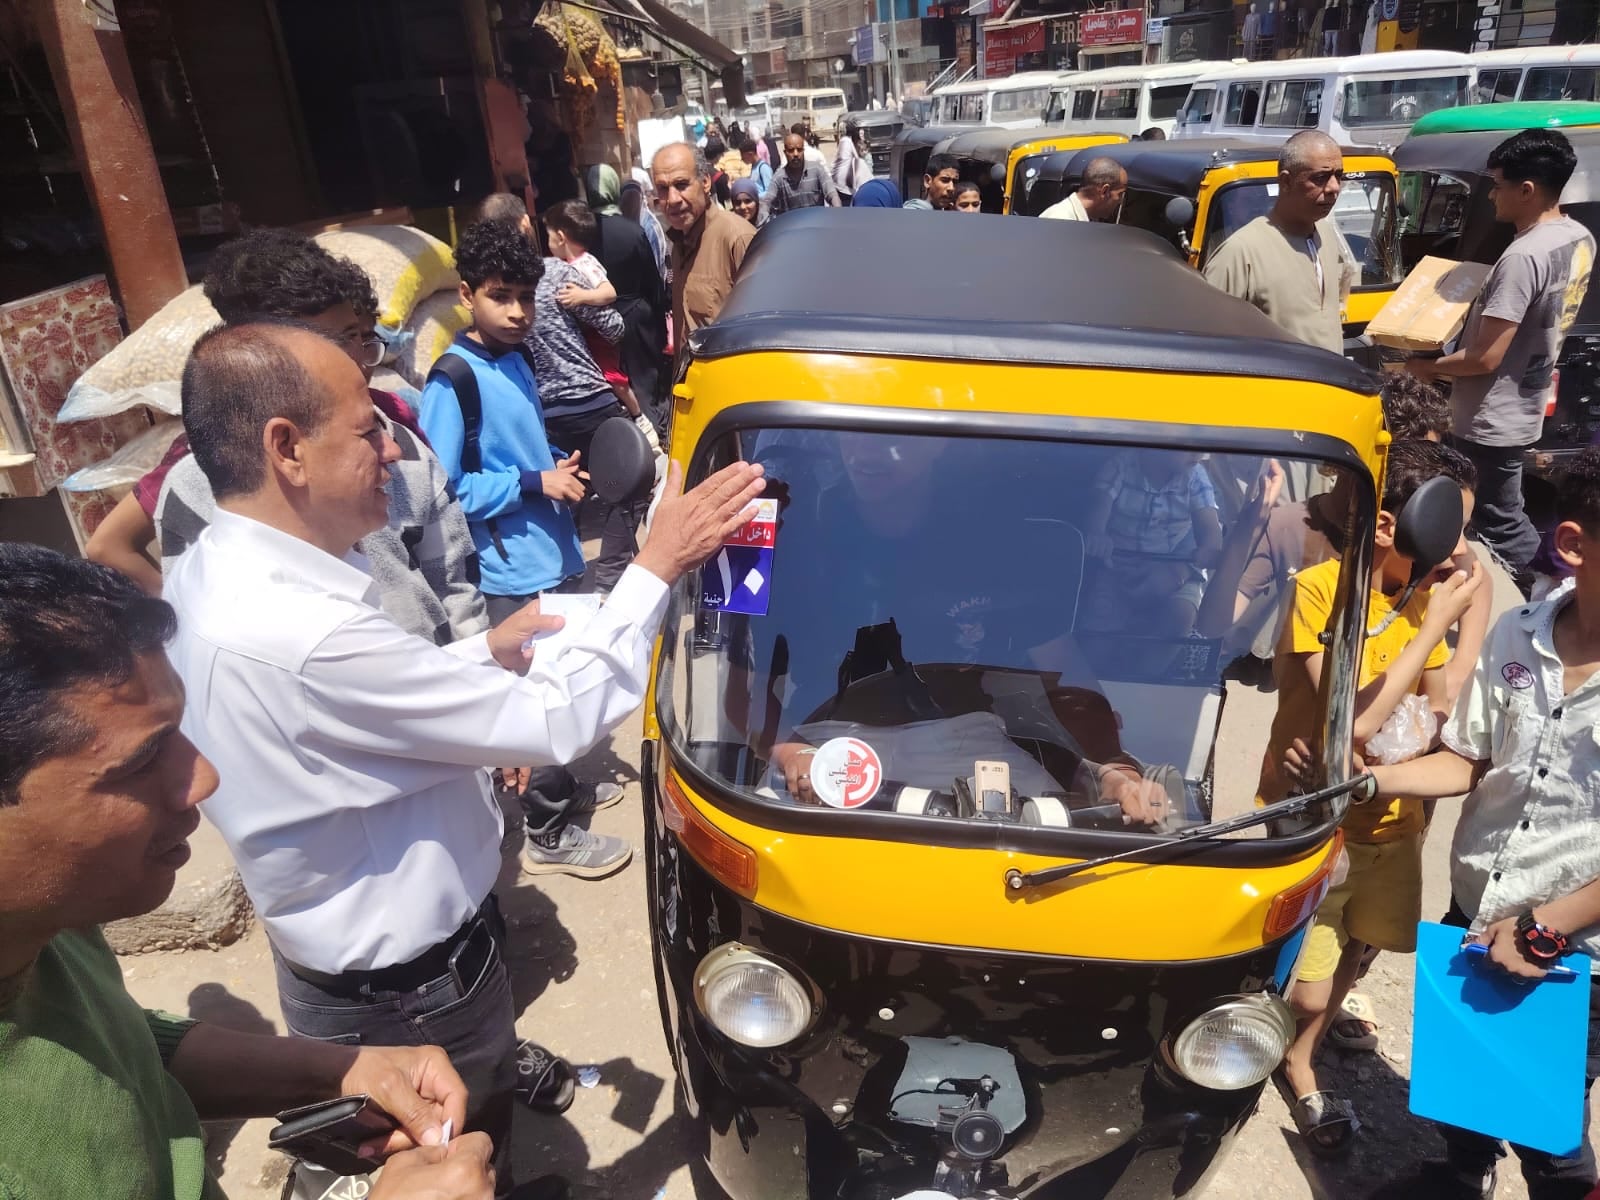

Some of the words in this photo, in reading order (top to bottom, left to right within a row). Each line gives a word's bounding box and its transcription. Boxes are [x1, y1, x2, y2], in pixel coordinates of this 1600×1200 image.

[1117, 15, 1137, 30] مستر
[746, 526, 771, 543] داخل
[536, 833, 556, 847] IKE
